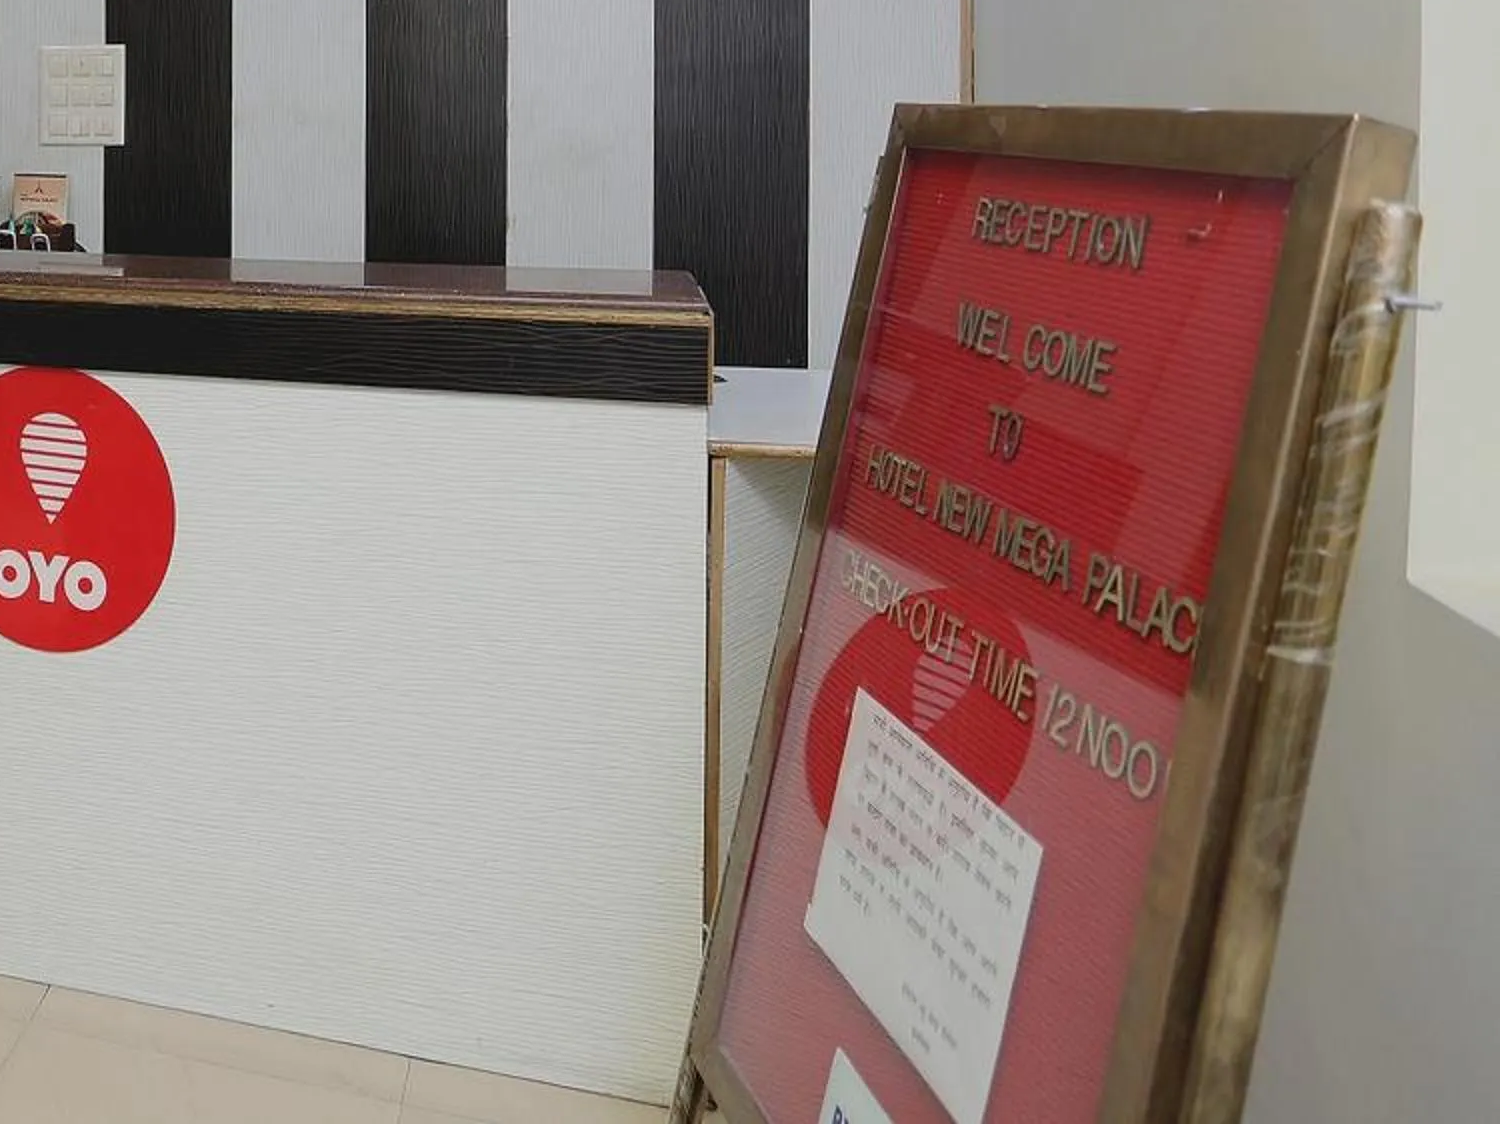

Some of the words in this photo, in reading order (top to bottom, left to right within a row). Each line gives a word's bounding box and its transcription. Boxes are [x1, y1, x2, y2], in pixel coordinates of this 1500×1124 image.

[971, 196, 1150, 269] RECEPTION
[988, 403, 1025, 460] TO
[864, 444, 932, 516] HOTEL
[933, 479, 995, 544] NEW
[993, 507, 1073, 592] MEGA
[1082, 550, 1205, 667] PALAC
[968, 628, 1041, 724] TIME
